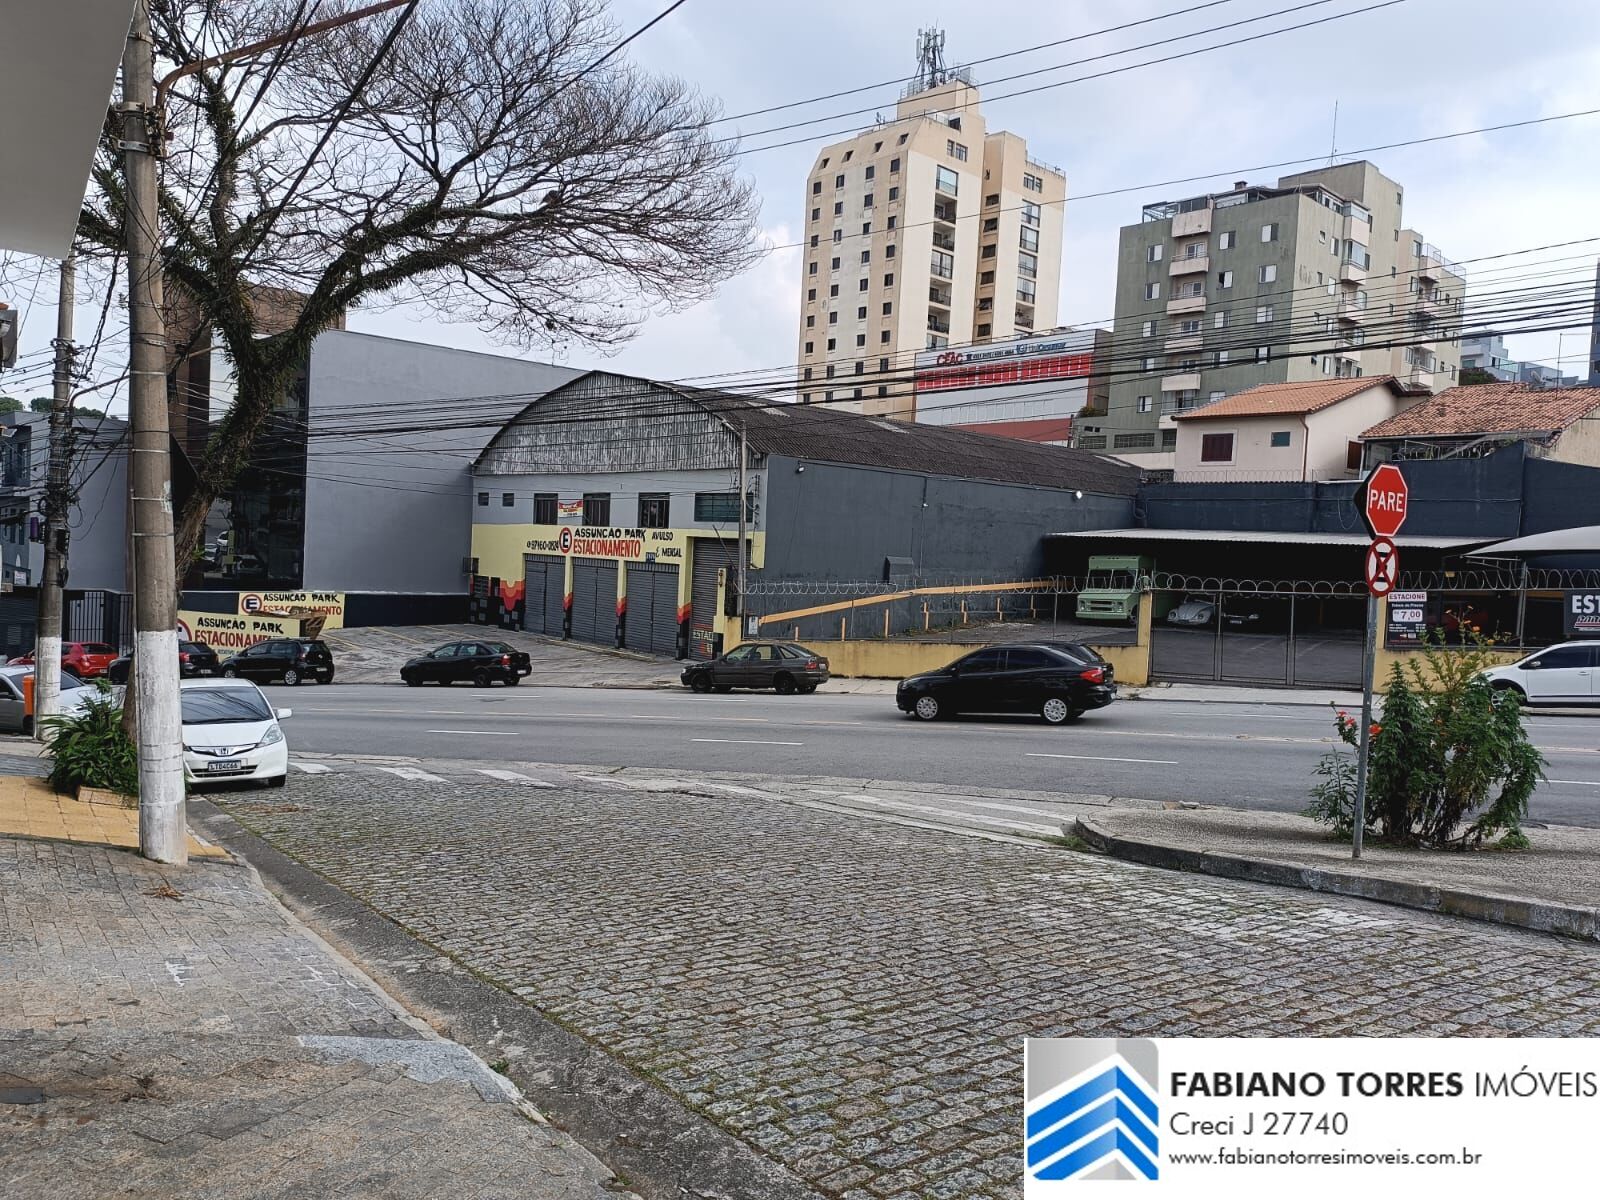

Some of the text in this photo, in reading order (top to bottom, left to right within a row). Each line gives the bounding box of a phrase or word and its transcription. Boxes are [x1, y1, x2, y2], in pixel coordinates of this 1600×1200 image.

[1369, 489, 1404, 513] PARE
[624, 529, 646, 542] PARK
[652, 531, 673, 541] AVULSO
[573, 539, 641, 558] ESTACIONAMENTO
[312, 593, 340, 603] PARK
[1389, 593, 1426, 601] ESTACIONE
[253, 621, 284, 634] PARK
